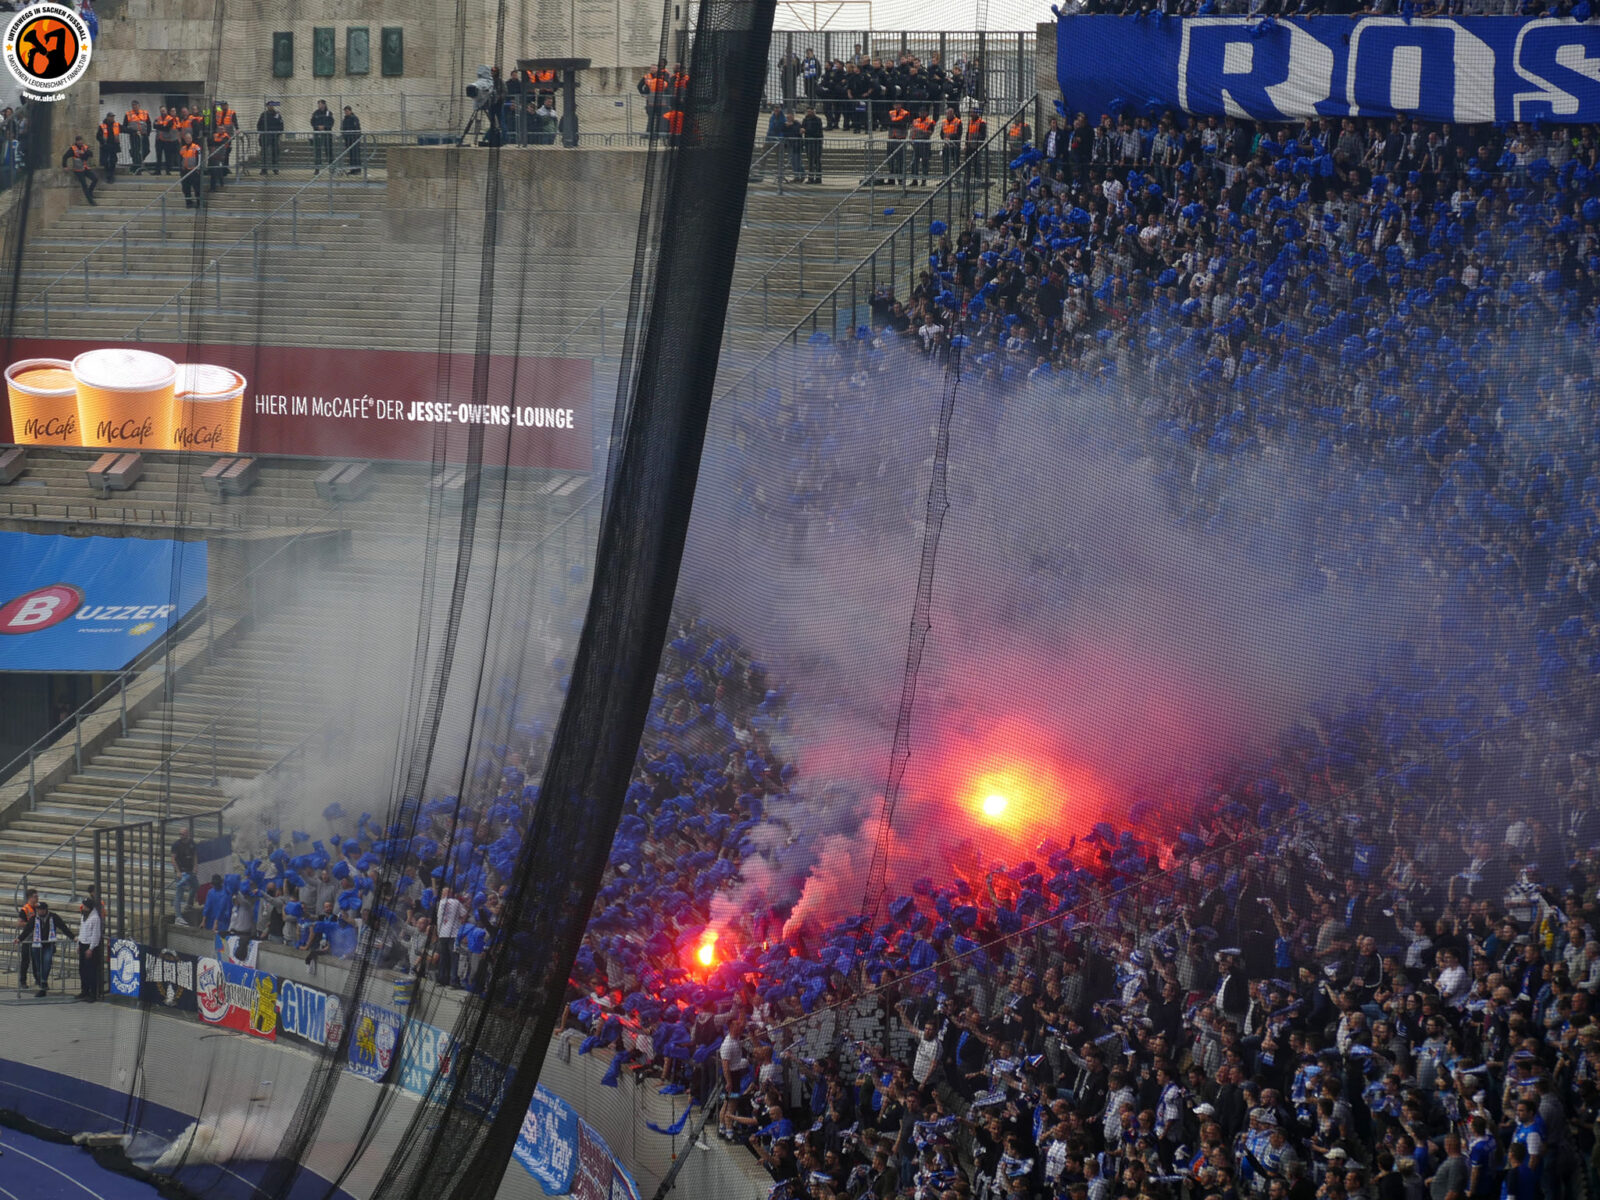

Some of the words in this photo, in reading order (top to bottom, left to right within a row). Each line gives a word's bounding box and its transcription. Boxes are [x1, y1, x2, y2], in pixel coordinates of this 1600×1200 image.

[255, 394, 287, 415] HIER
[291, 396, 308, 416] IM
[376, 399, 404, 421] DER
[407, 401, 574, 429] JESSE-OWENS-LOUNGE
[24, 414, 76, 441] McCafé
[96, 416, 153, 444] McCafé
[174, 425, 223, 448] McCafé
